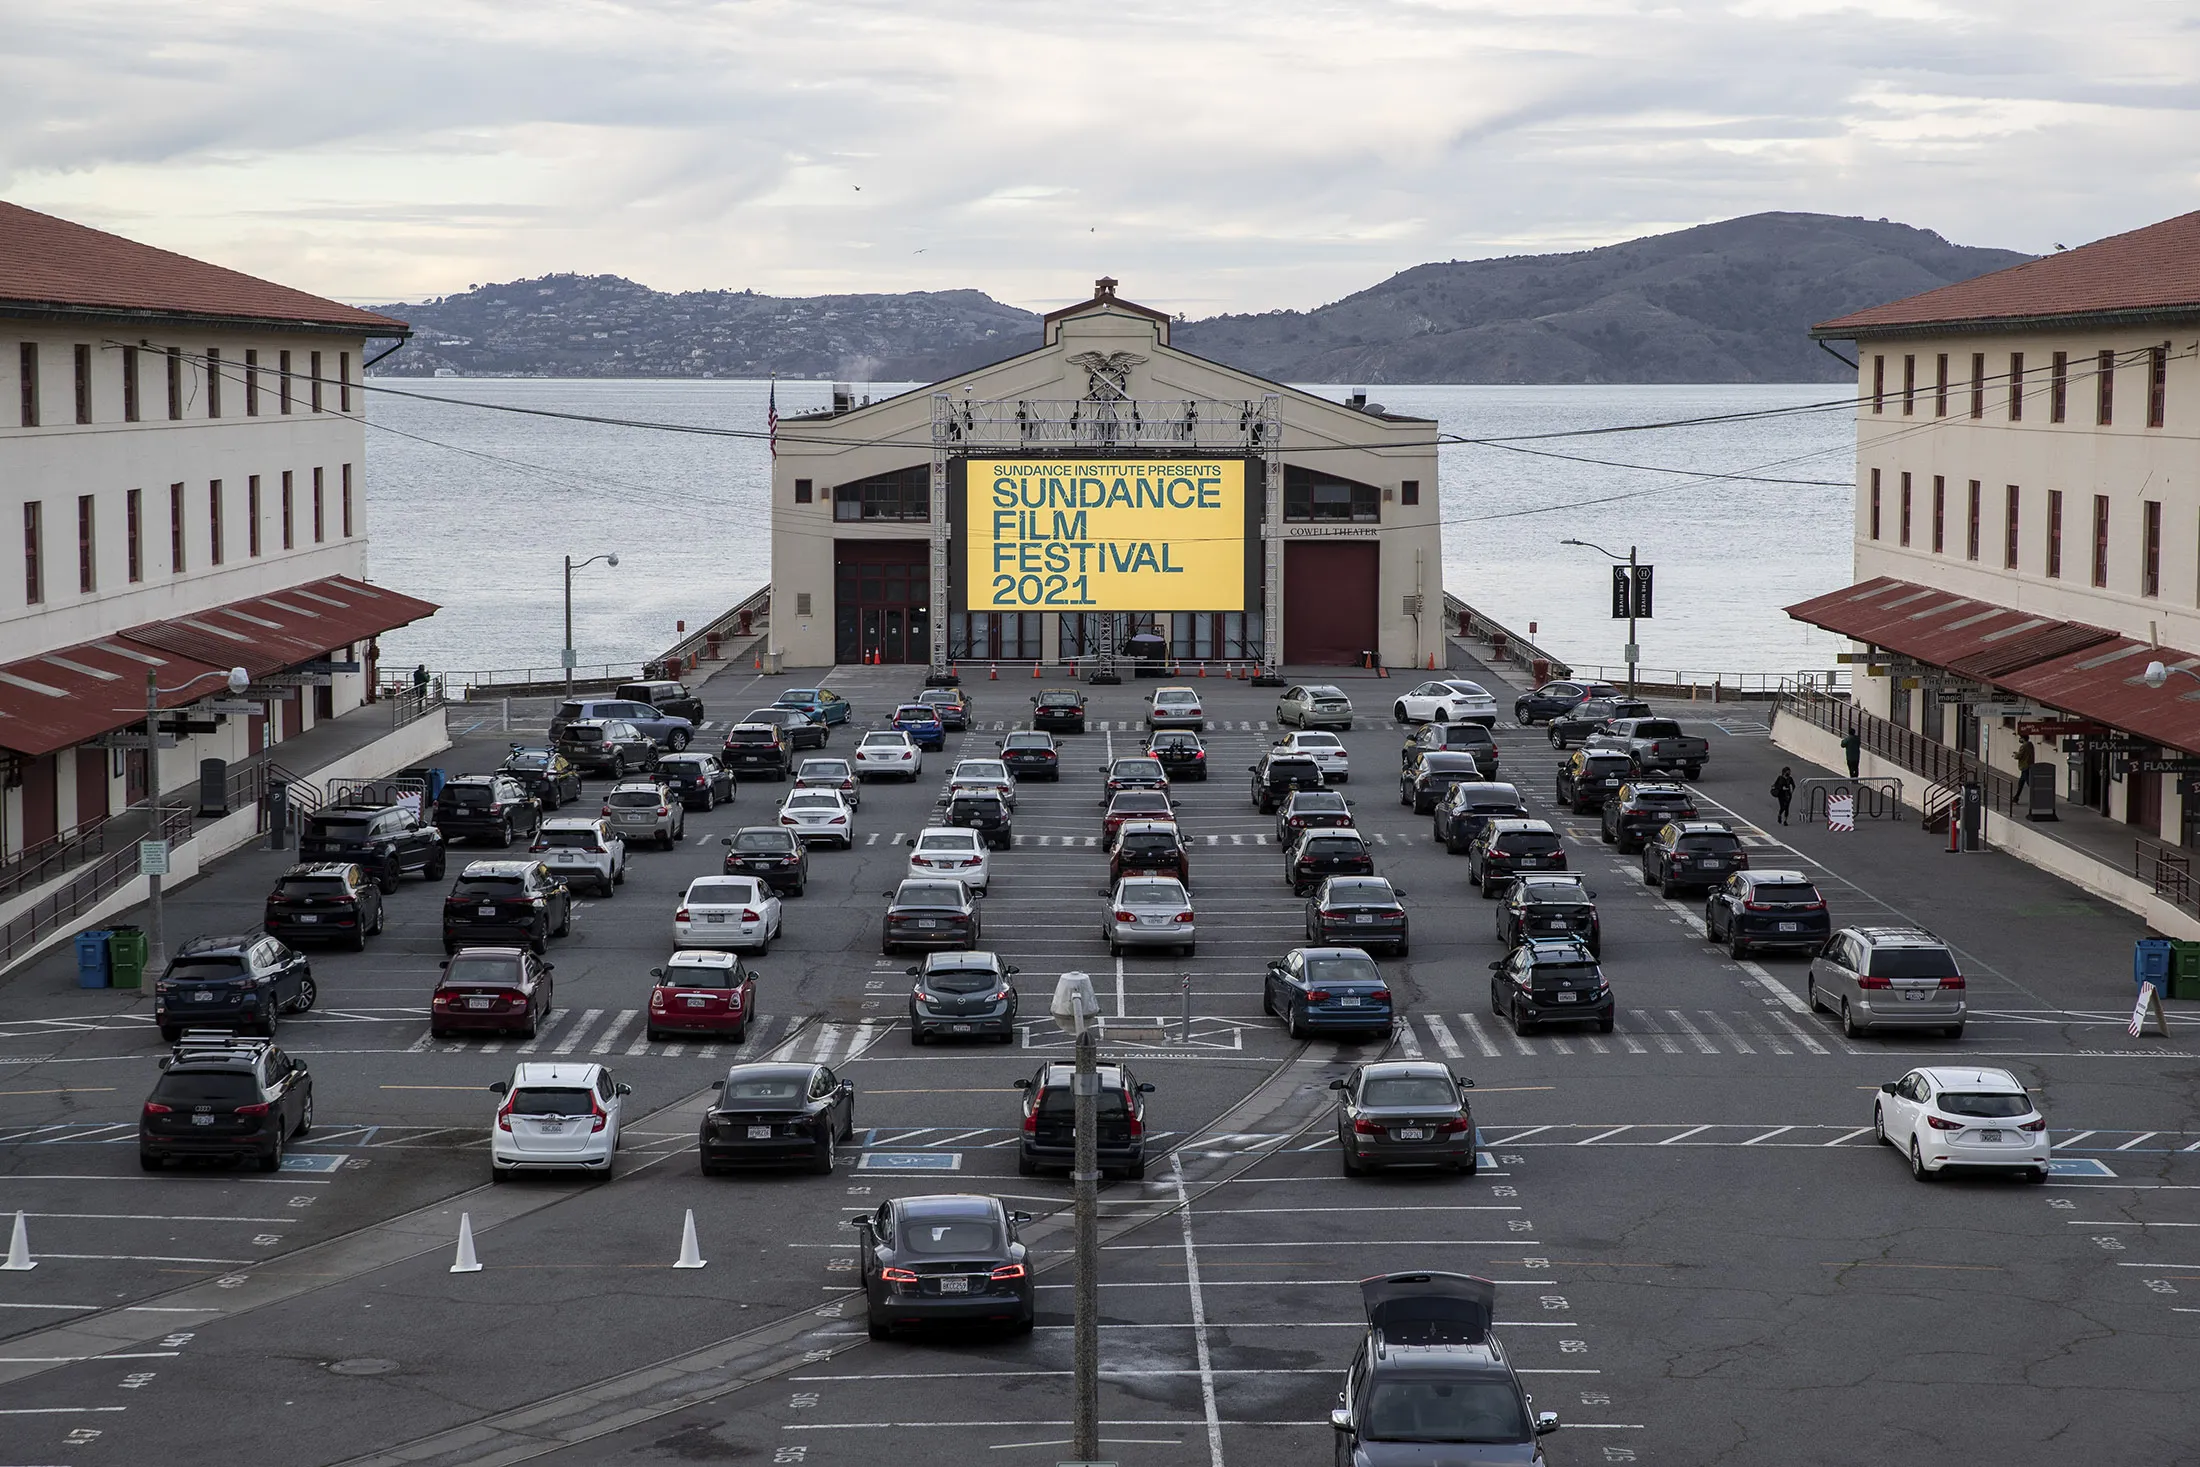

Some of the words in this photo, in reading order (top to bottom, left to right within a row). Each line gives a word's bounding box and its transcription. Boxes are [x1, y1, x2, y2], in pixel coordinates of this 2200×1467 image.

[993, 465, 1071, 476] SUNDANCE
[1075, 465, 1145, 476] INSTITUTE
[1149, 465, 1221, 476] PRESENTS
[993, 478, 1221, 508] SUNDANCE
[993, 510, 1087, 540] FILM
[1290, 528, 1331, 536] COWELL
[1333, 527, 1378, 536] THEATER
[993, 543, 1183, 572] FESTIVAL
[993, 574, 1096, 605] 2021
[2144, 762, 2173, 770] FLAX
[1540, 1296, 1570, 1309] 520
[1559, 1340, 1588, 1352] 519
[790, 1393, 819, 1408] 506
[774, 1446, 807, 1462] 505
[1603, 1447, 1637, 1462] 517
